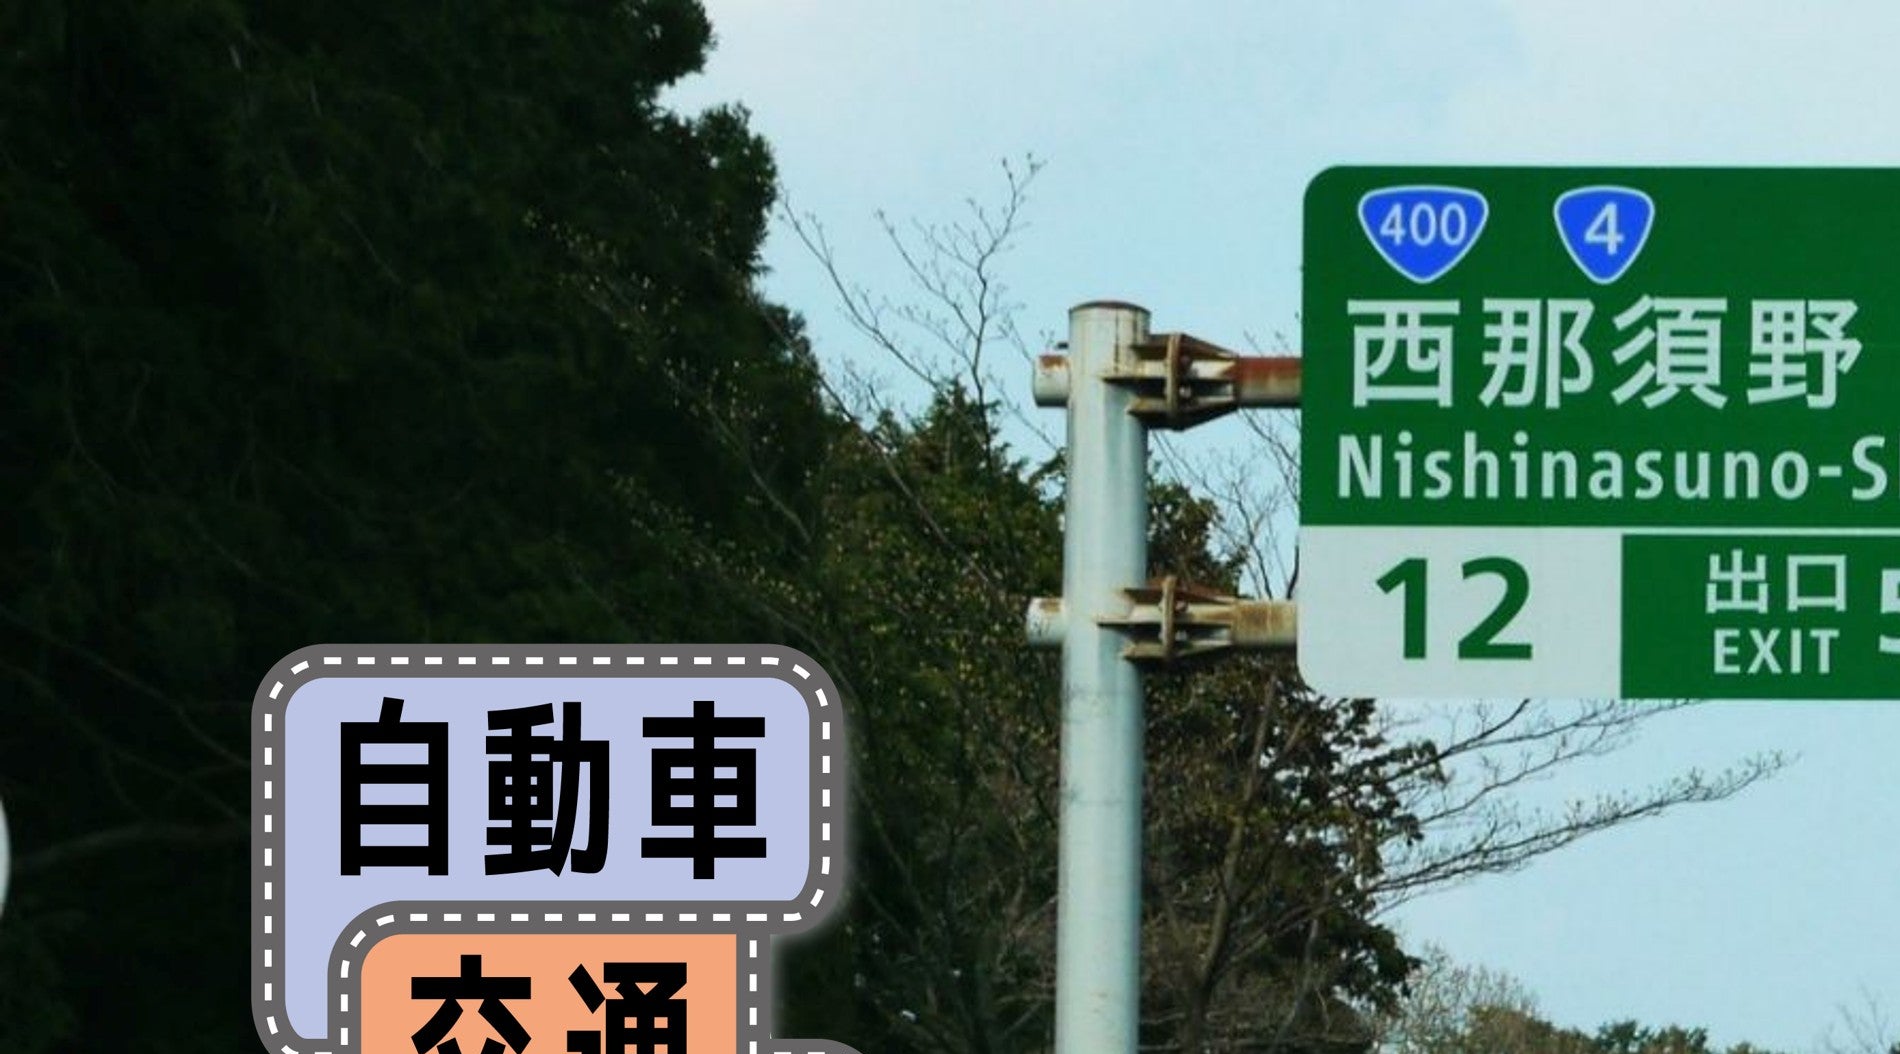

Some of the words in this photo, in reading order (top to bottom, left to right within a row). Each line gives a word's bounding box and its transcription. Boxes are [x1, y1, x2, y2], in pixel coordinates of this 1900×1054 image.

[1380, 203, 1468, 247] 400
[1585, 203, 1623, 254] 4
[1347, 295, 1863, 409] 西那須野
[1376, 556, 1533, 660] 12
[1706, 549, 1846, 614] 出口
[1714, 629, 1839, 674] EXIT
